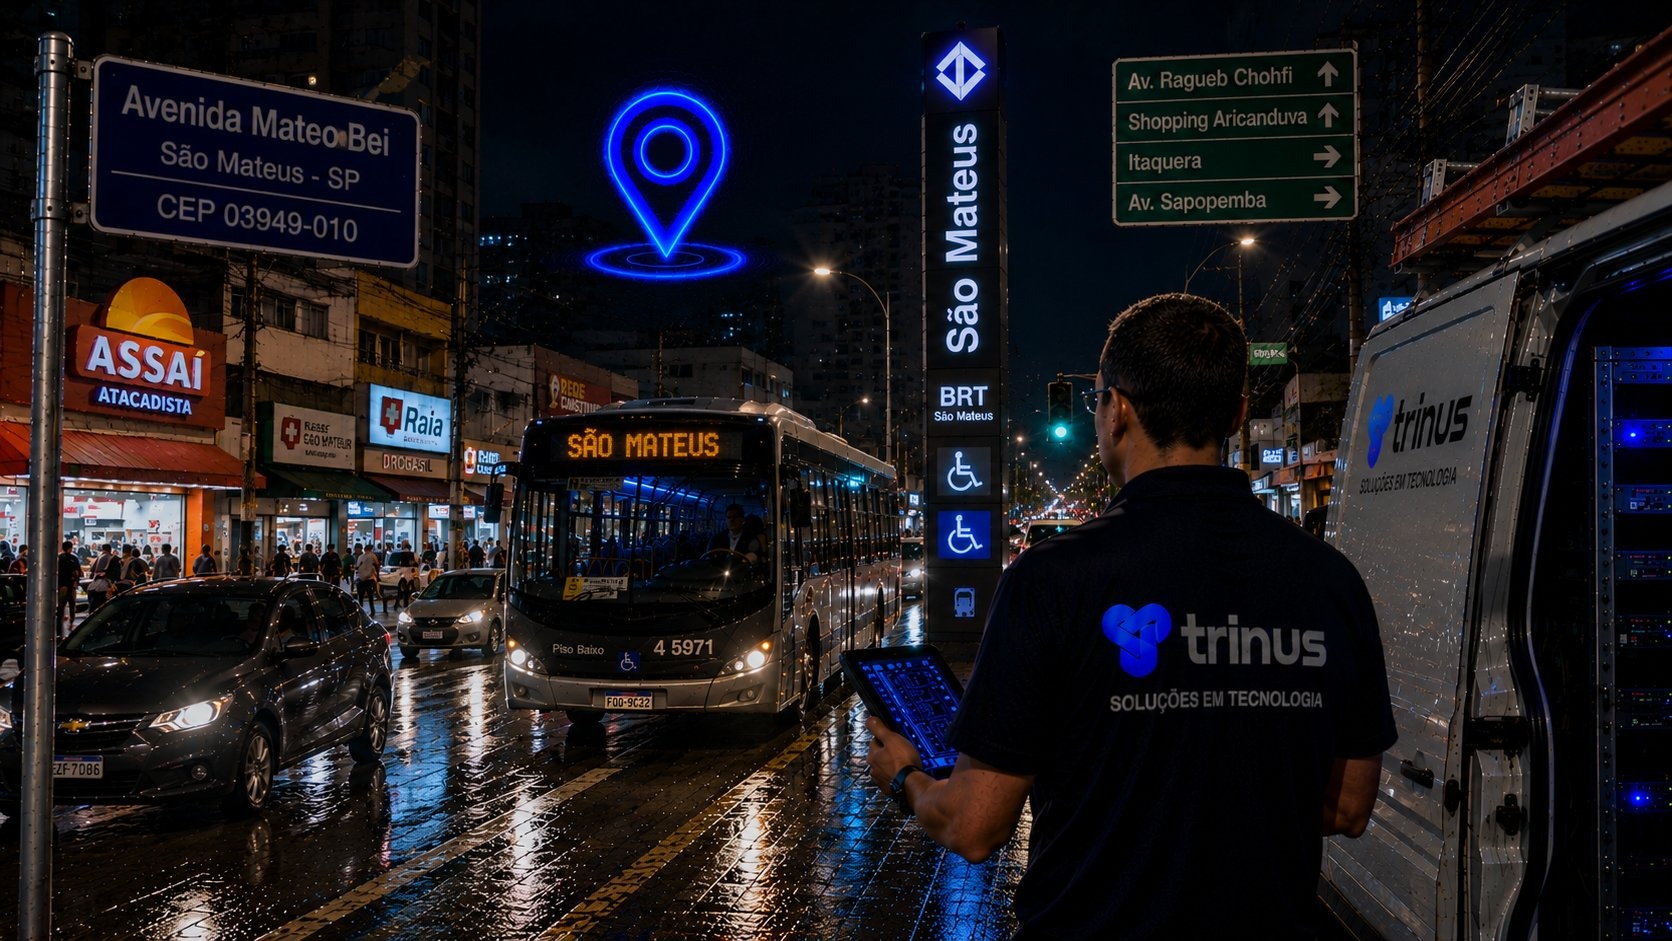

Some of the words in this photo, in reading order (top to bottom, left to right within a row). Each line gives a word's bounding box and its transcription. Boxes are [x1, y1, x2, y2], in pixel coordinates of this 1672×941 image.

[1128, 72, 1154, 90] Av.
[1160, 67, 1228, 92] Ragueb
[1233, 66, 1294, 86] Chohfi
[121, 84, 242, 133] Avenida
[252, 105, 338, 149] Mateo
[348, 122, 390, 156] Bei
[1128, 112, 1209, 133] Shopping
[1213, 108, 1308, 128] Aricanduva
[160, 141, 209, 170] São
[217, 150, 305, 185] Mateus
[327, 167, 360, 191] SP
[1128, 153, 1202, 174] Itaquera
[945, 123, 978, 263] Mateus
[1128, 194, 1155, 212] Av.
[1161, 191, 1267, 213] Sapopemba
[157, 194, 216, 223] CEP
[223, 203, 358, 243] 03949-010
[946, 278, 979, 353] São
[86, 334, 205, 391] ASSAÍ
[98, 386, 193, 416] ATACADISTA
[940, 386, 988, 407] BRT
[404, 407, 443, 438] Raia
[934, 411, 954, 422] São
[957, 411, 994, 422] Mateus
[1393, 392, 1473, 454] trinus
[567, 428, 613, 459] SÃO
[625, 432, 720, 458] MATEUS
[1360, 472, 1394, 495] SOLUÇÕES
[1395, 472, 1407, 490] EM
[1407, 467, 1457, 489] TECNOLOGIA
[552, 643, 573, 656] Piso
[577, 644, 605, 656] Baixo
[654, 640, 667, 656] 4
[671, 639, 714, 656] 5971
[1182, 613, 1327, 668] trinus
[1110, 689, 1199, 713] SOLUÇÕES
[1204, 691, 1225, 707] EM
[1228, 691, 1324, 708] TECNOLOGIA
